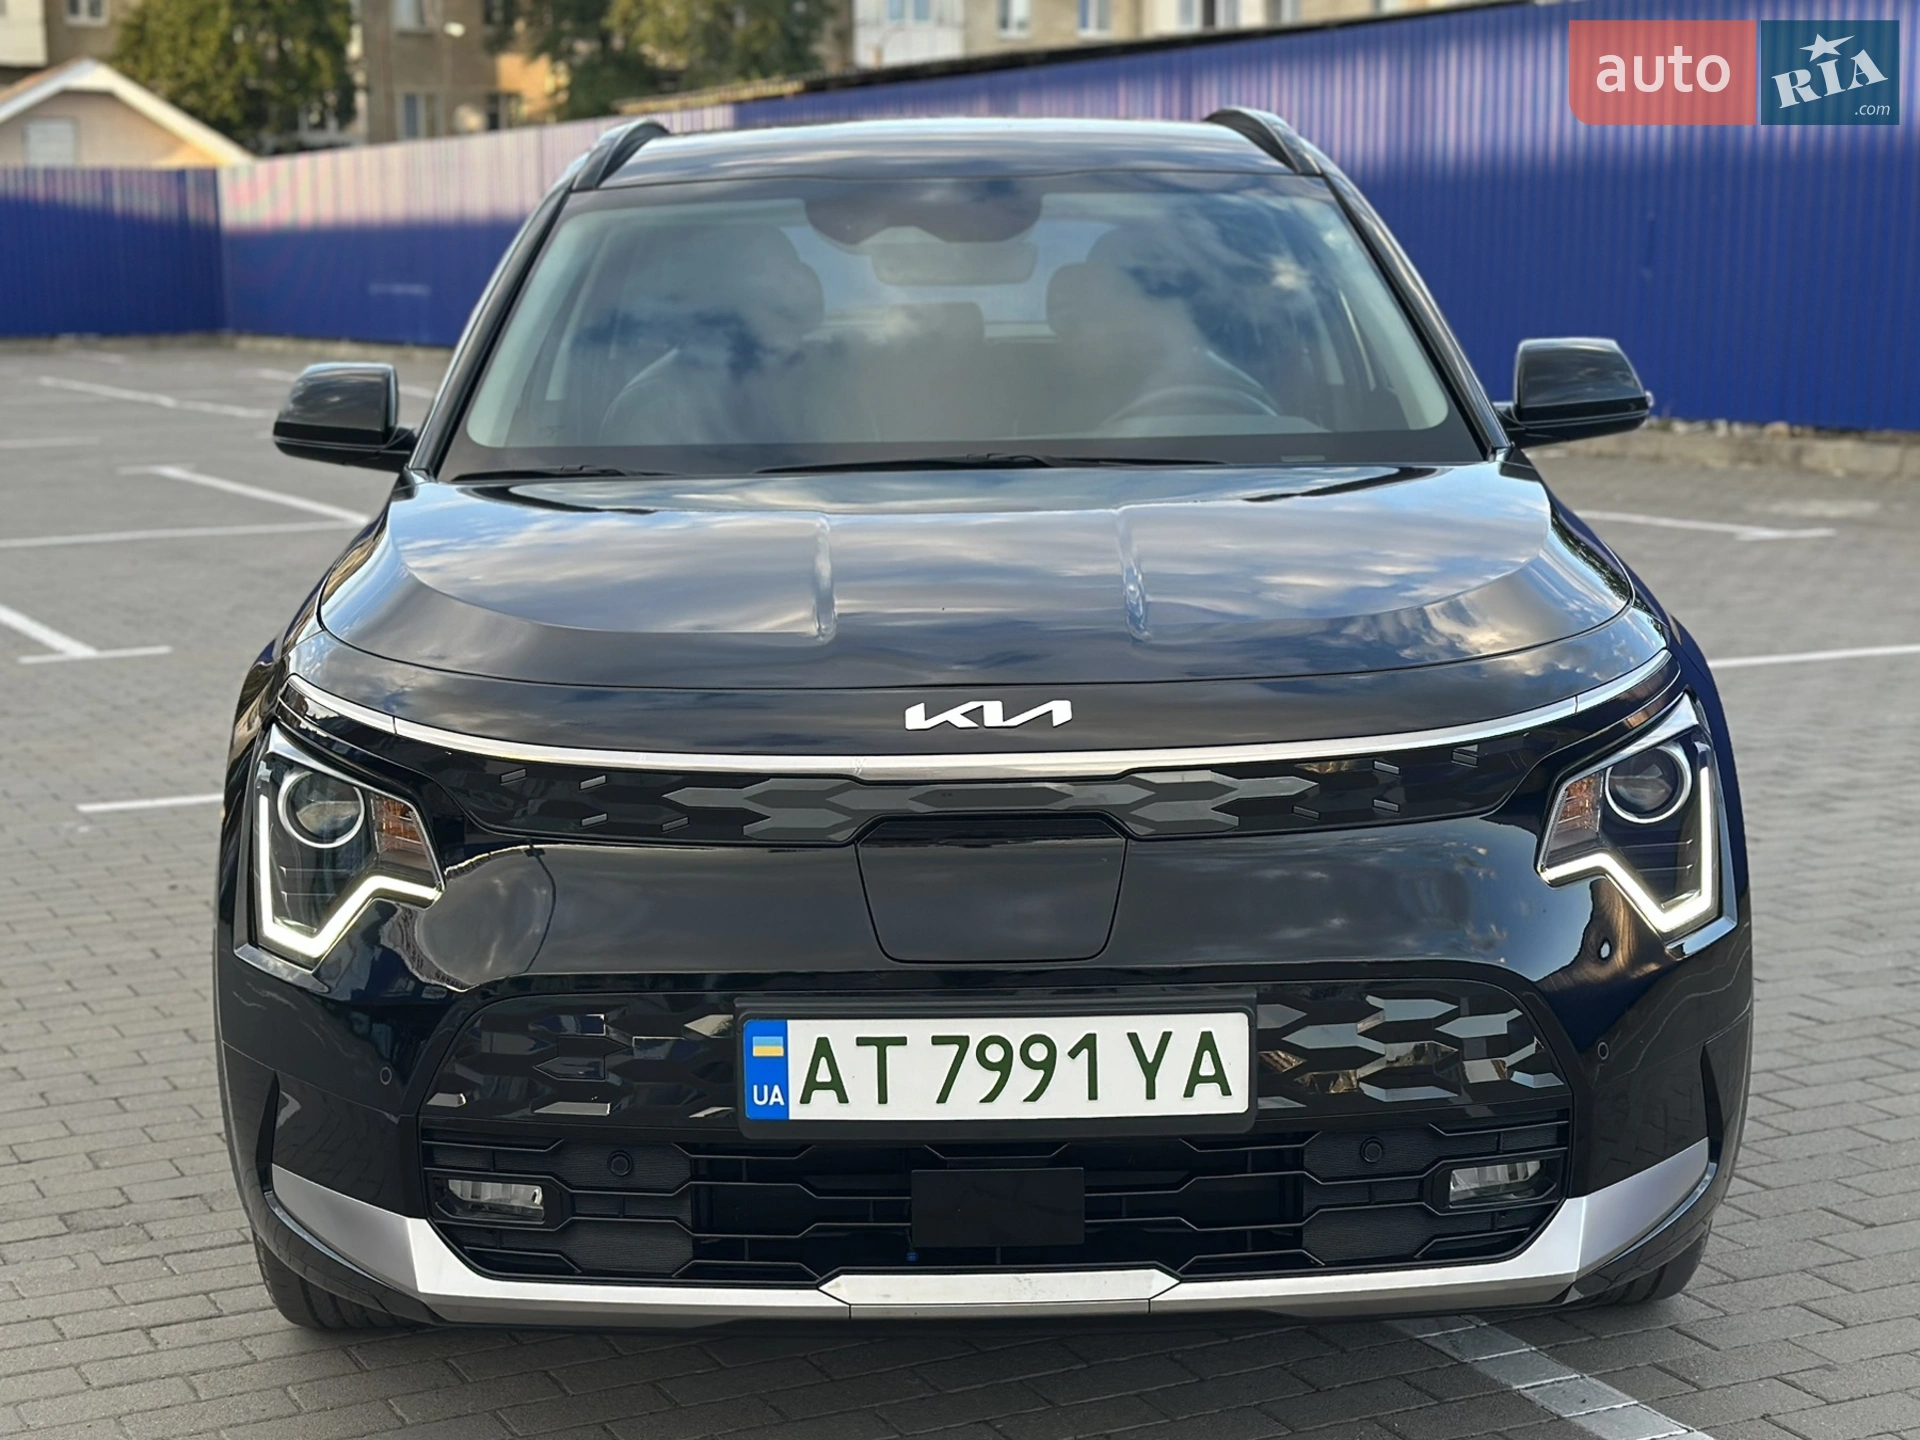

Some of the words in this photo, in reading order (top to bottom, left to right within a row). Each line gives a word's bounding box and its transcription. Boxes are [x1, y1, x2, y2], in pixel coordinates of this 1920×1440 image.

[905, 700, 1073, 730] KIA
[799, 1036, 908, 1105] AT
[931, 1033, 1098, 1104] 7991
[1126, 1030, 1233, 1100] YA
[753, 1085, 785, 1106] UA
